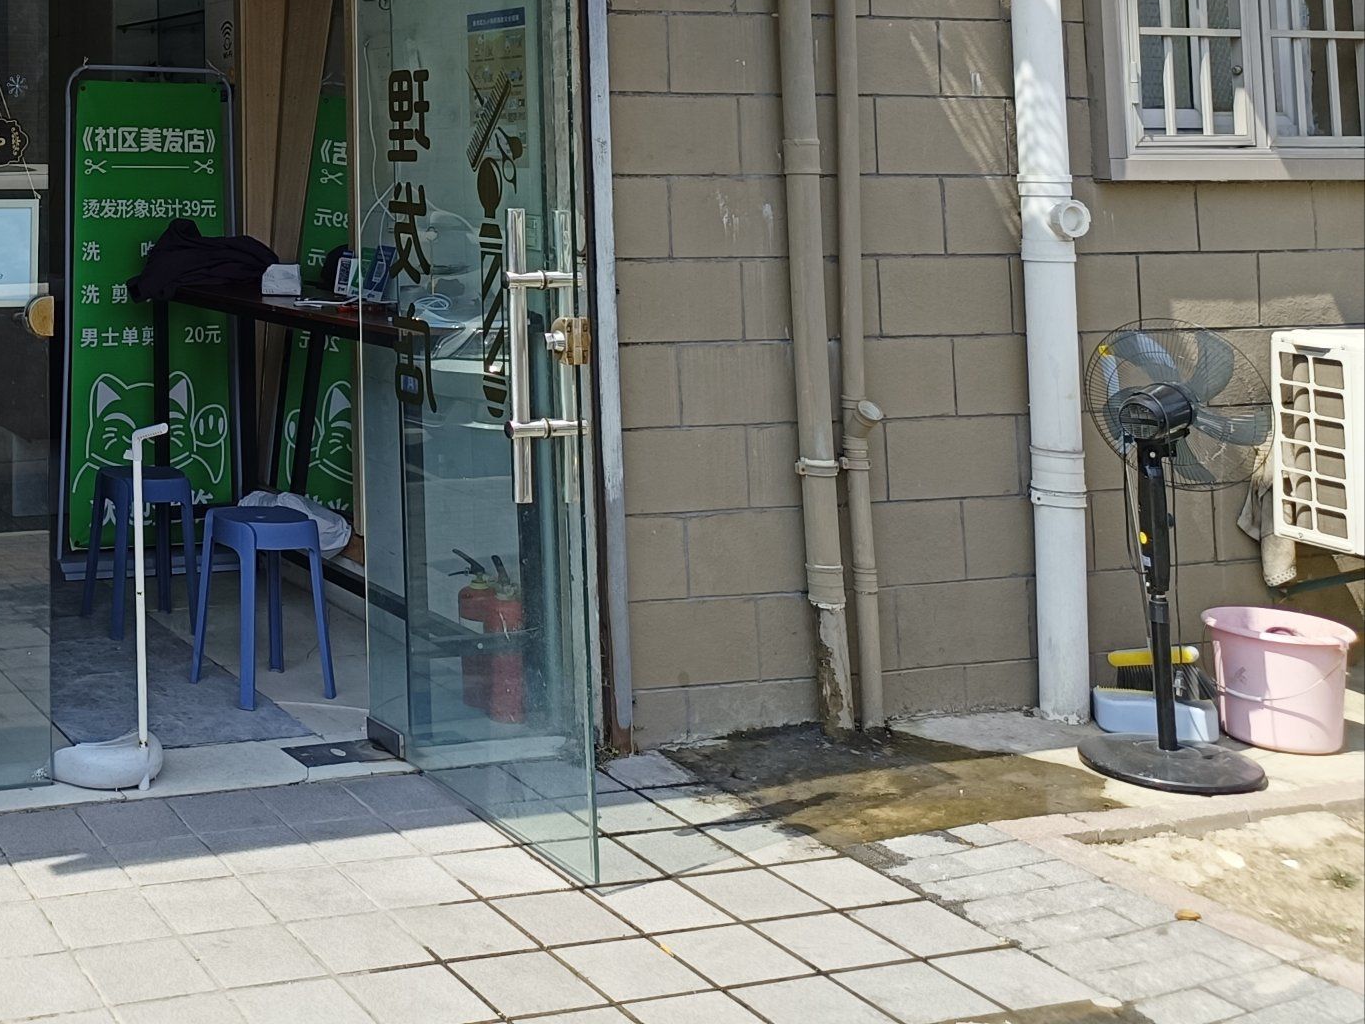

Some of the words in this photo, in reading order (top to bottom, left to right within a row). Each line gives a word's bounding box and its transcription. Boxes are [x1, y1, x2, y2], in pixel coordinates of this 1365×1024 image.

[82, 198, 217, 218] 烫发形象设计39元
[81, 241, 101, 262] 洗
[184, 325, 222, 344] 20元
